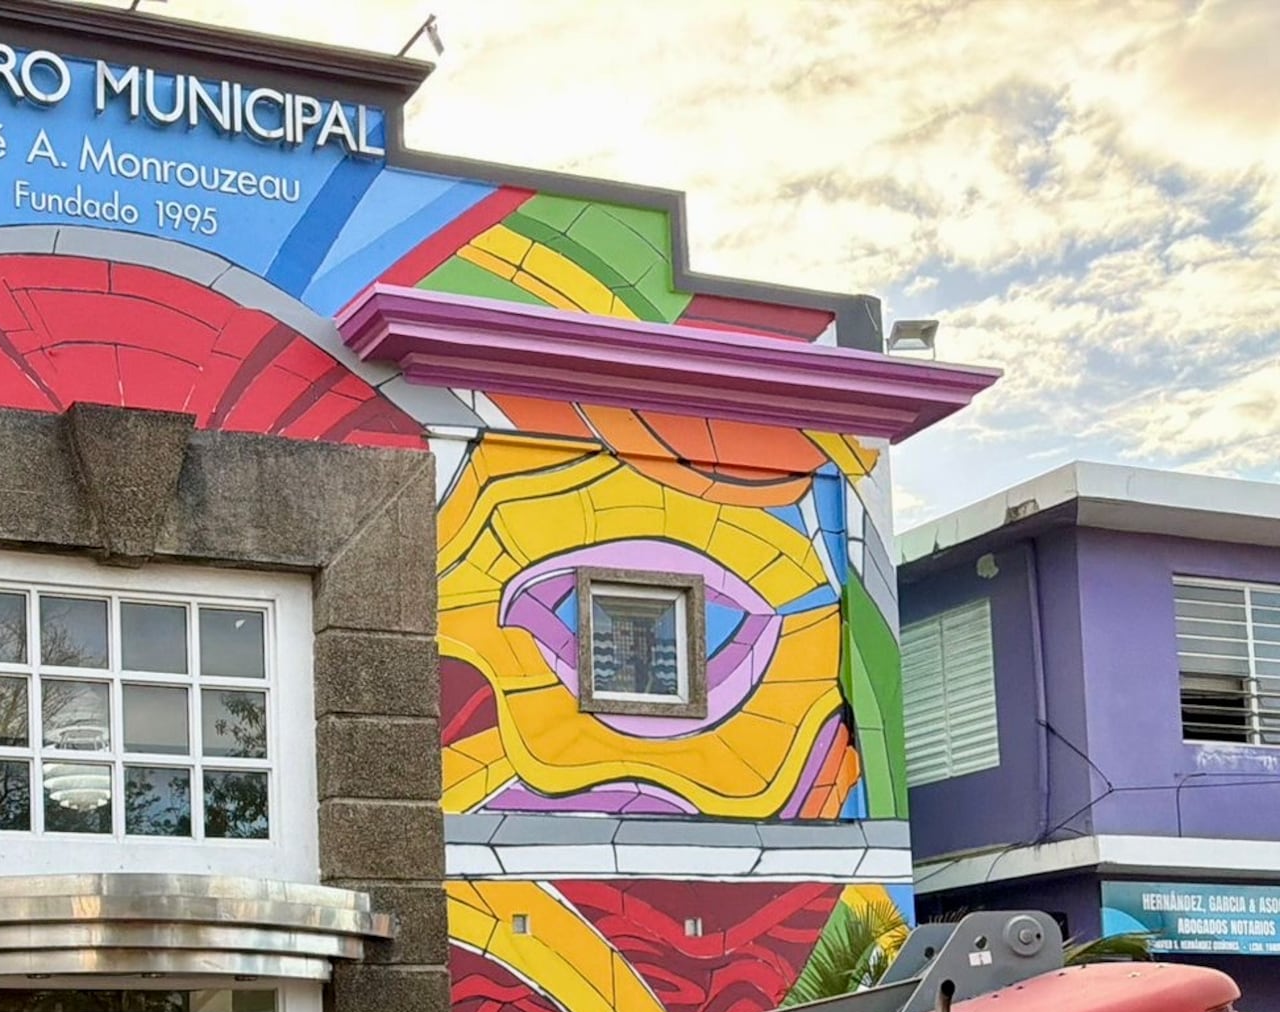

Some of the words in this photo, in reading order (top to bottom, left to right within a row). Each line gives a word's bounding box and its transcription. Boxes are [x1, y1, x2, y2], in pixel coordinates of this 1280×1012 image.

[95, 59, 386, 156] MUNICIPAL
[26, 127, 68, 169] A.
[79, 134, 301, 203] Monrouzeau
[14, 179, 139, 226] Fundado
[155, 199, 219, 236] 1995
[1177, 917, 1228, 935] ABOGADOS
[1231, 919, 1276, 936] NOTARIOS
[1249, 899, 1256, 913] &
[1259, 897, 1280, 914] ASO
